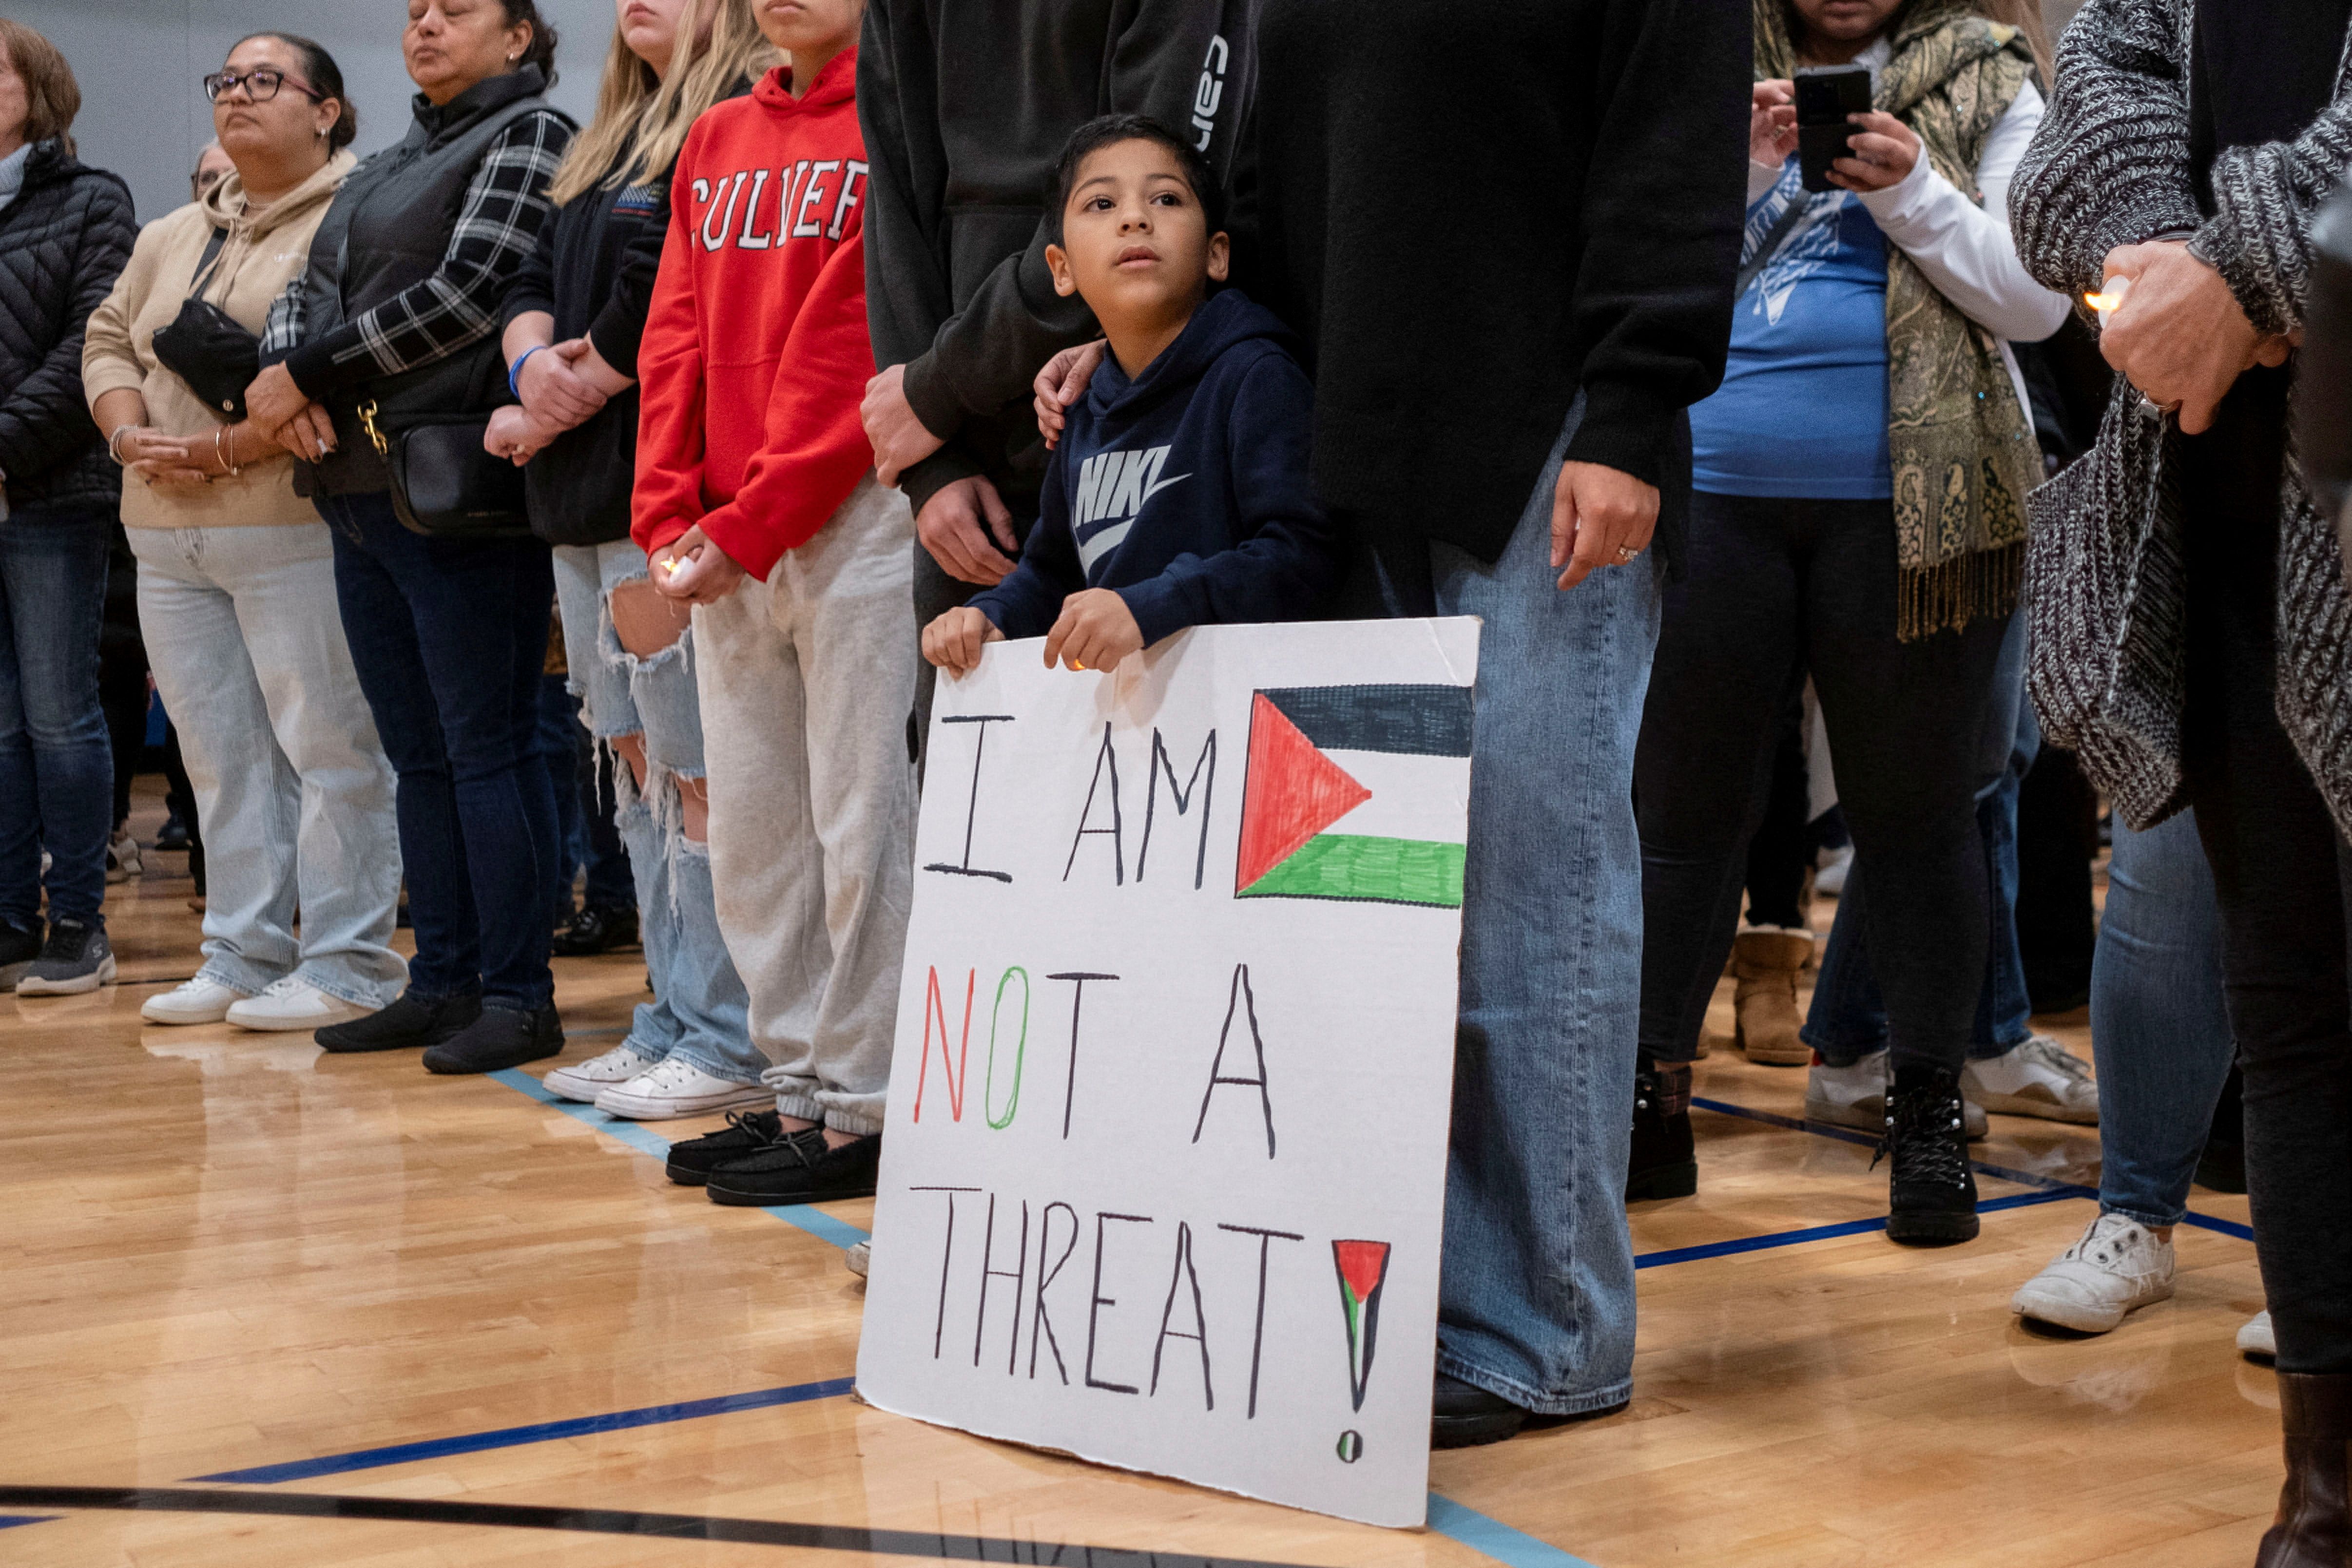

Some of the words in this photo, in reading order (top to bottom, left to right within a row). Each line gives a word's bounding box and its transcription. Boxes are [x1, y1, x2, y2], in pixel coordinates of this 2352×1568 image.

[924, 714, 1015, 883] I
[1062, 721, 1216, 890] AM
[913, 965, 1120, 1139] NOT
[1192, 963, 1275, 1160] A
[909, 1186, 1391, 1463] THREAT!
